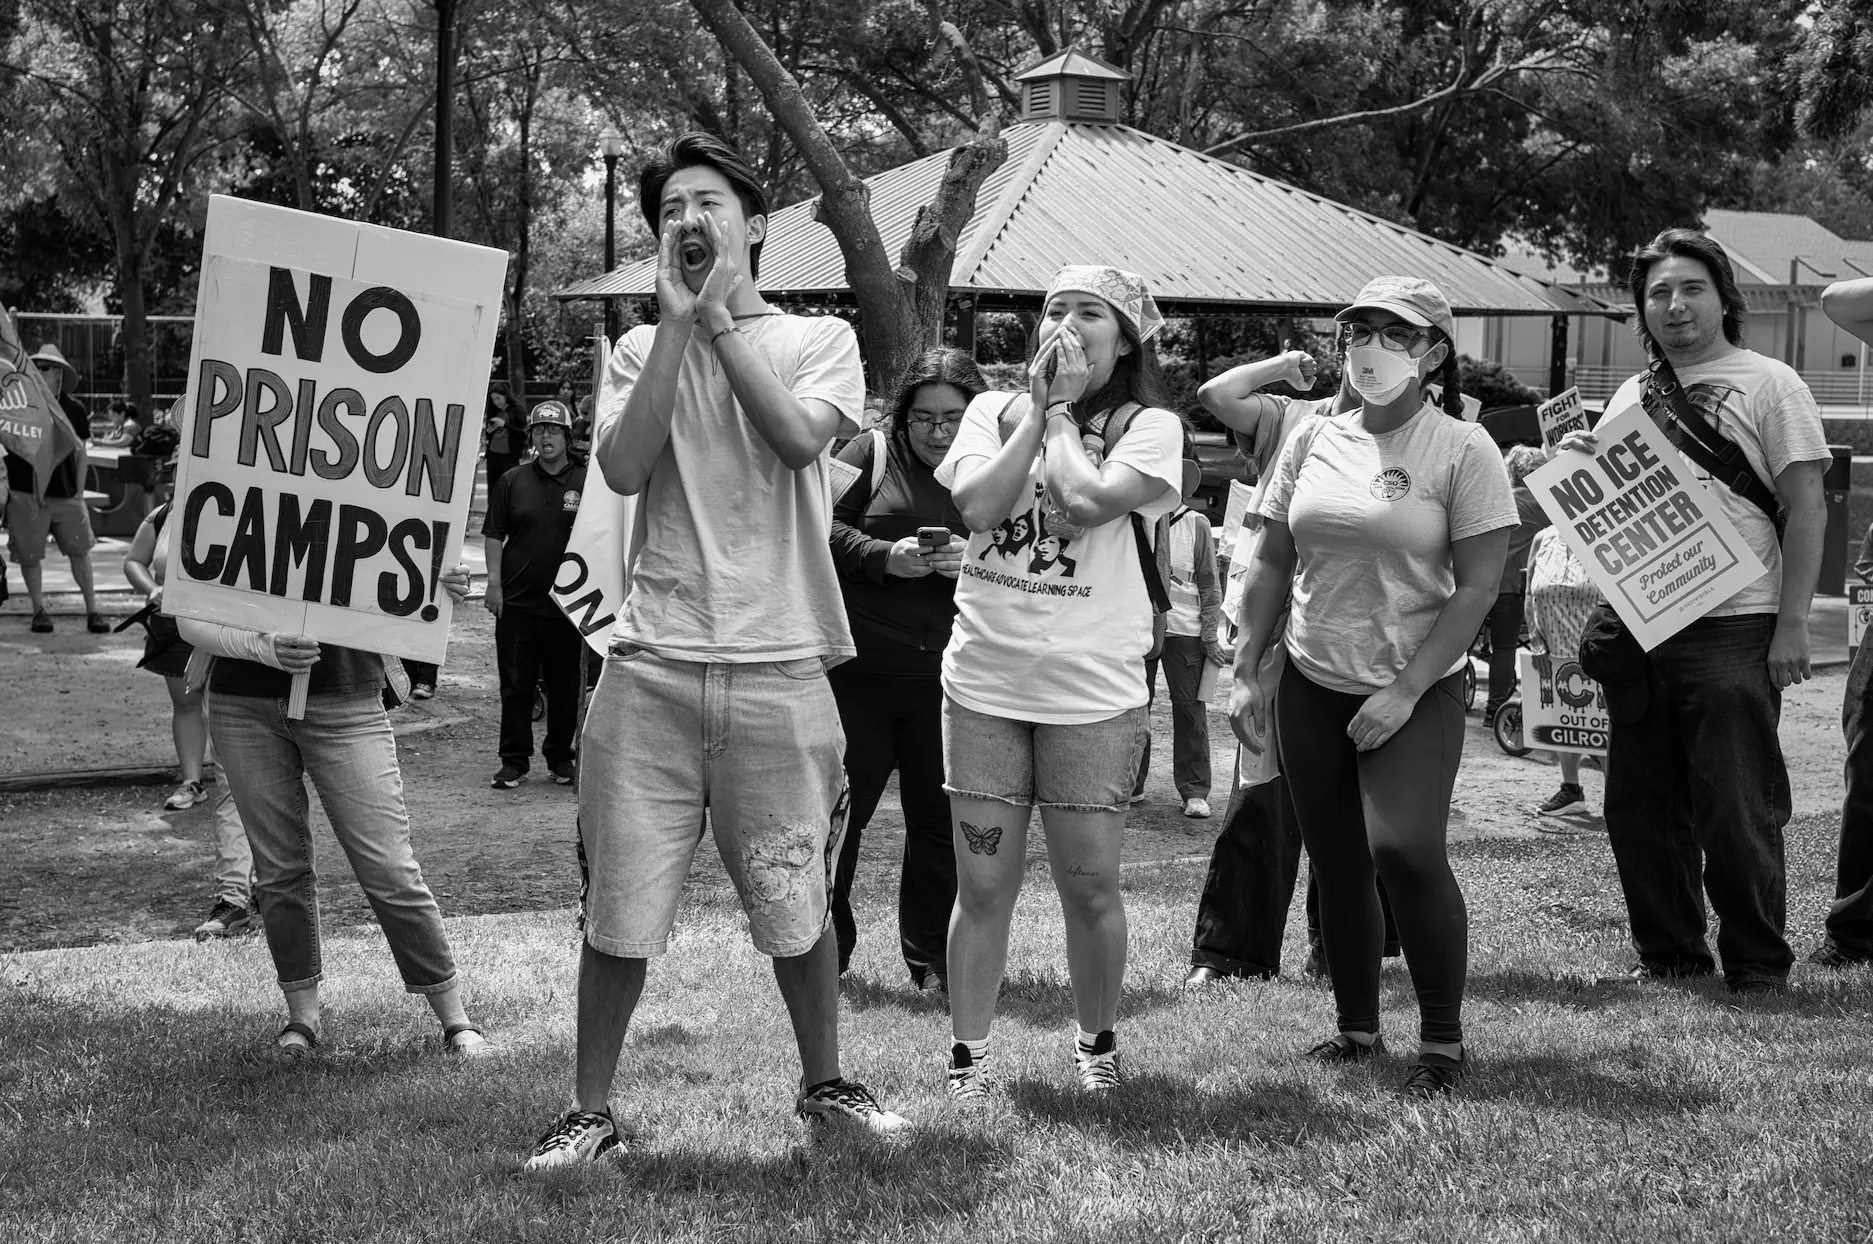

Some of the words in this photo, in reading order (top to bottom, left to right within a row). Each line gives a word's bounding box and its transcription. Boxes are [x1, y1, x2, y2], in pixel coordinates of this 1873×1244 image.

[261, 266, 421, 374] NO
[1362, 367, 1374, 375] 3M
[191, 359, 465, 503] PRISON
[1541, 392, 1577, 421] FIGHT
[1556, 412, 1570, 423] FOR
[1549, 468, 1604, 521] NO
[1595, 429, 1661, 490] ICE
[1574, 465, 1680, 546] DETENTION
[181, 481, 451, 622] CAMPS!
[1593, 491, 1704, 576] CENTER
[962, 563, 997, 583] HEALTHCARE
[996, 574, 1029, 592] ADVOCATE
[1028, 581, 1066, 597] LEARNING
[1067, 585, 1092, 598] SPACE
[1639, 552, 1683, 591] Protect
[1683, 540, 1704, 561] our
[1646, 554, 1716, 605] Community
[1857, 589, 1873, 603] CO
[1560, 714, 1587, 727] OUT
[1590, 717, 1609, 729] OF
